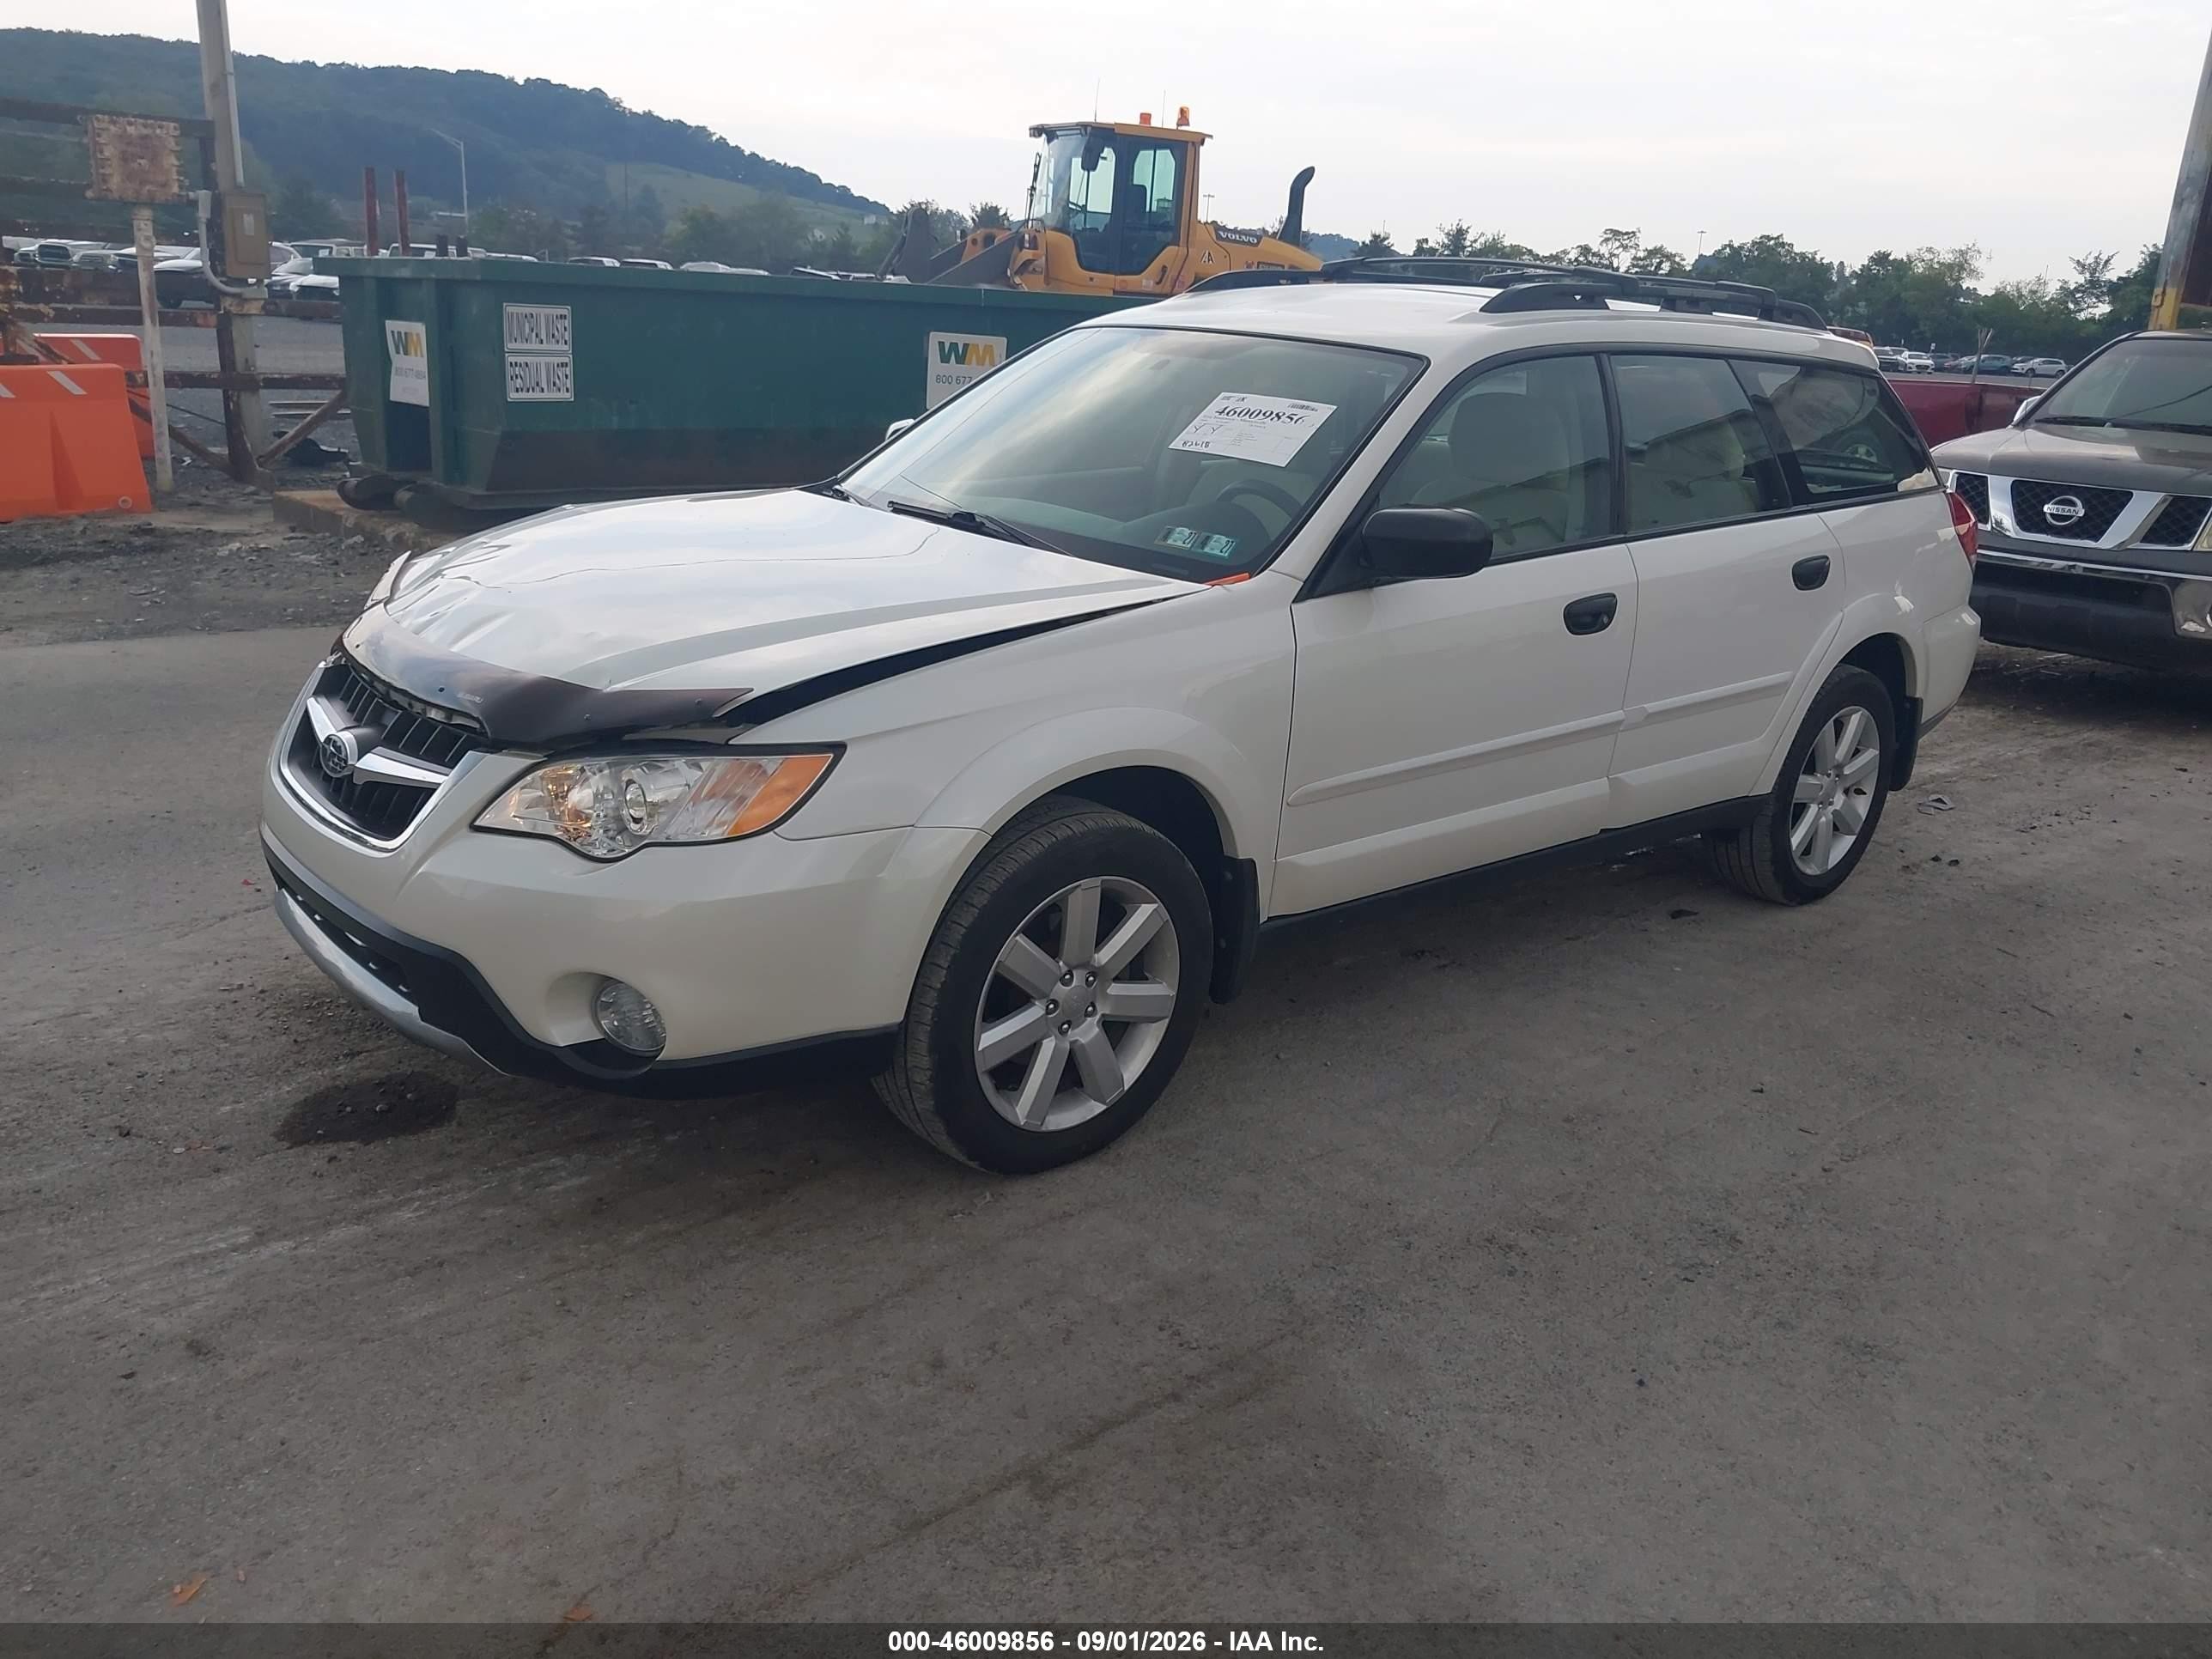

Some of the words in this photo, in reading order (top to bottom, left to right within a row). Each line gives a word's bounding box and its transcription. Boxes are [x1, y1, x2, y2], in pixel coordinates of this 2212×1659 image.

[1218, 230, 1258, 244] VOLVO
[507, 312, 544, 345] MUNICIPAL
[544, 313, 568, 346] WASTE
[391, 330, 424, 358] WM
[938, 341, 996, 368] WM
[509, 361, 545, 393] RESIDUAL
[544, 362, 570, 394] WASTE
[935, 374, 953, 386] 800
[1215, 405, 1310, 425] 46009856
[2046, 507, 2079, 515] NISSAN
[1219, 539, 1236, 554] 27
